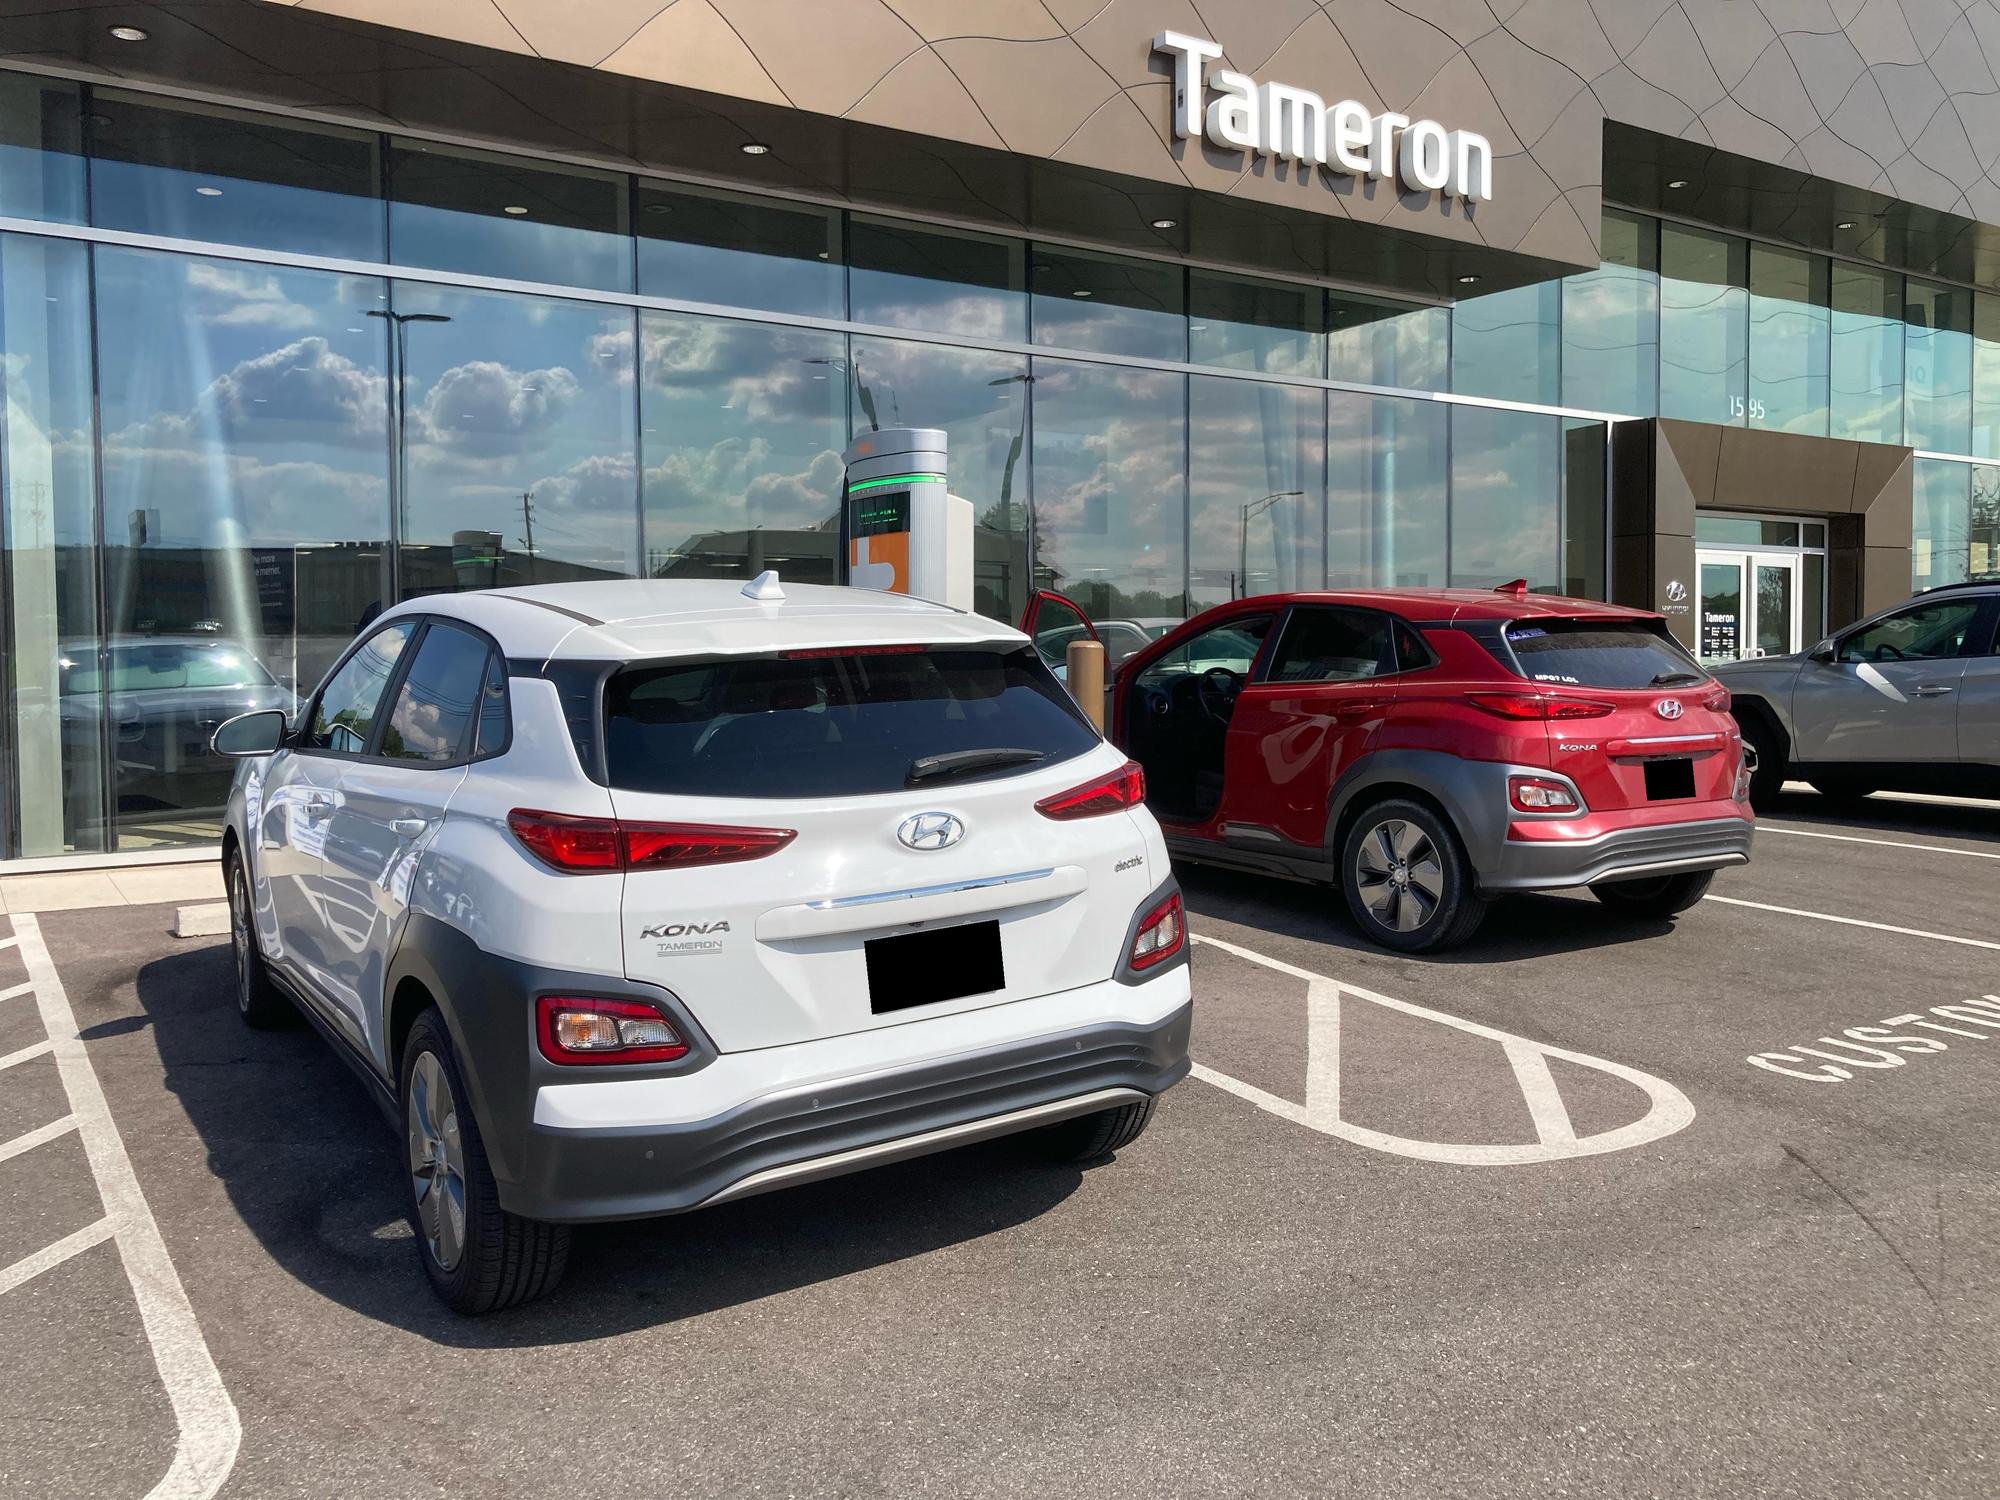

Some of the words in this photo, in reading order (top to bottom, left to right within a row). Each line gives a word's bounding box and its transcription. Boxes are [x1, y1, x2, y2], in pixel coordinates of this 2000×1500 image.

[1152, 30, 1492, 201] Tameron
[1728, 395, 1765, 420] 1595
[1704, 612, 1735, 623] Tameron
[1559, 743, 1598, 752] KONA
[1114, 854, 1143, 872] electric
[639, 920, 731, 940] KONA
[656, 940, 723, 951] TAMERON
